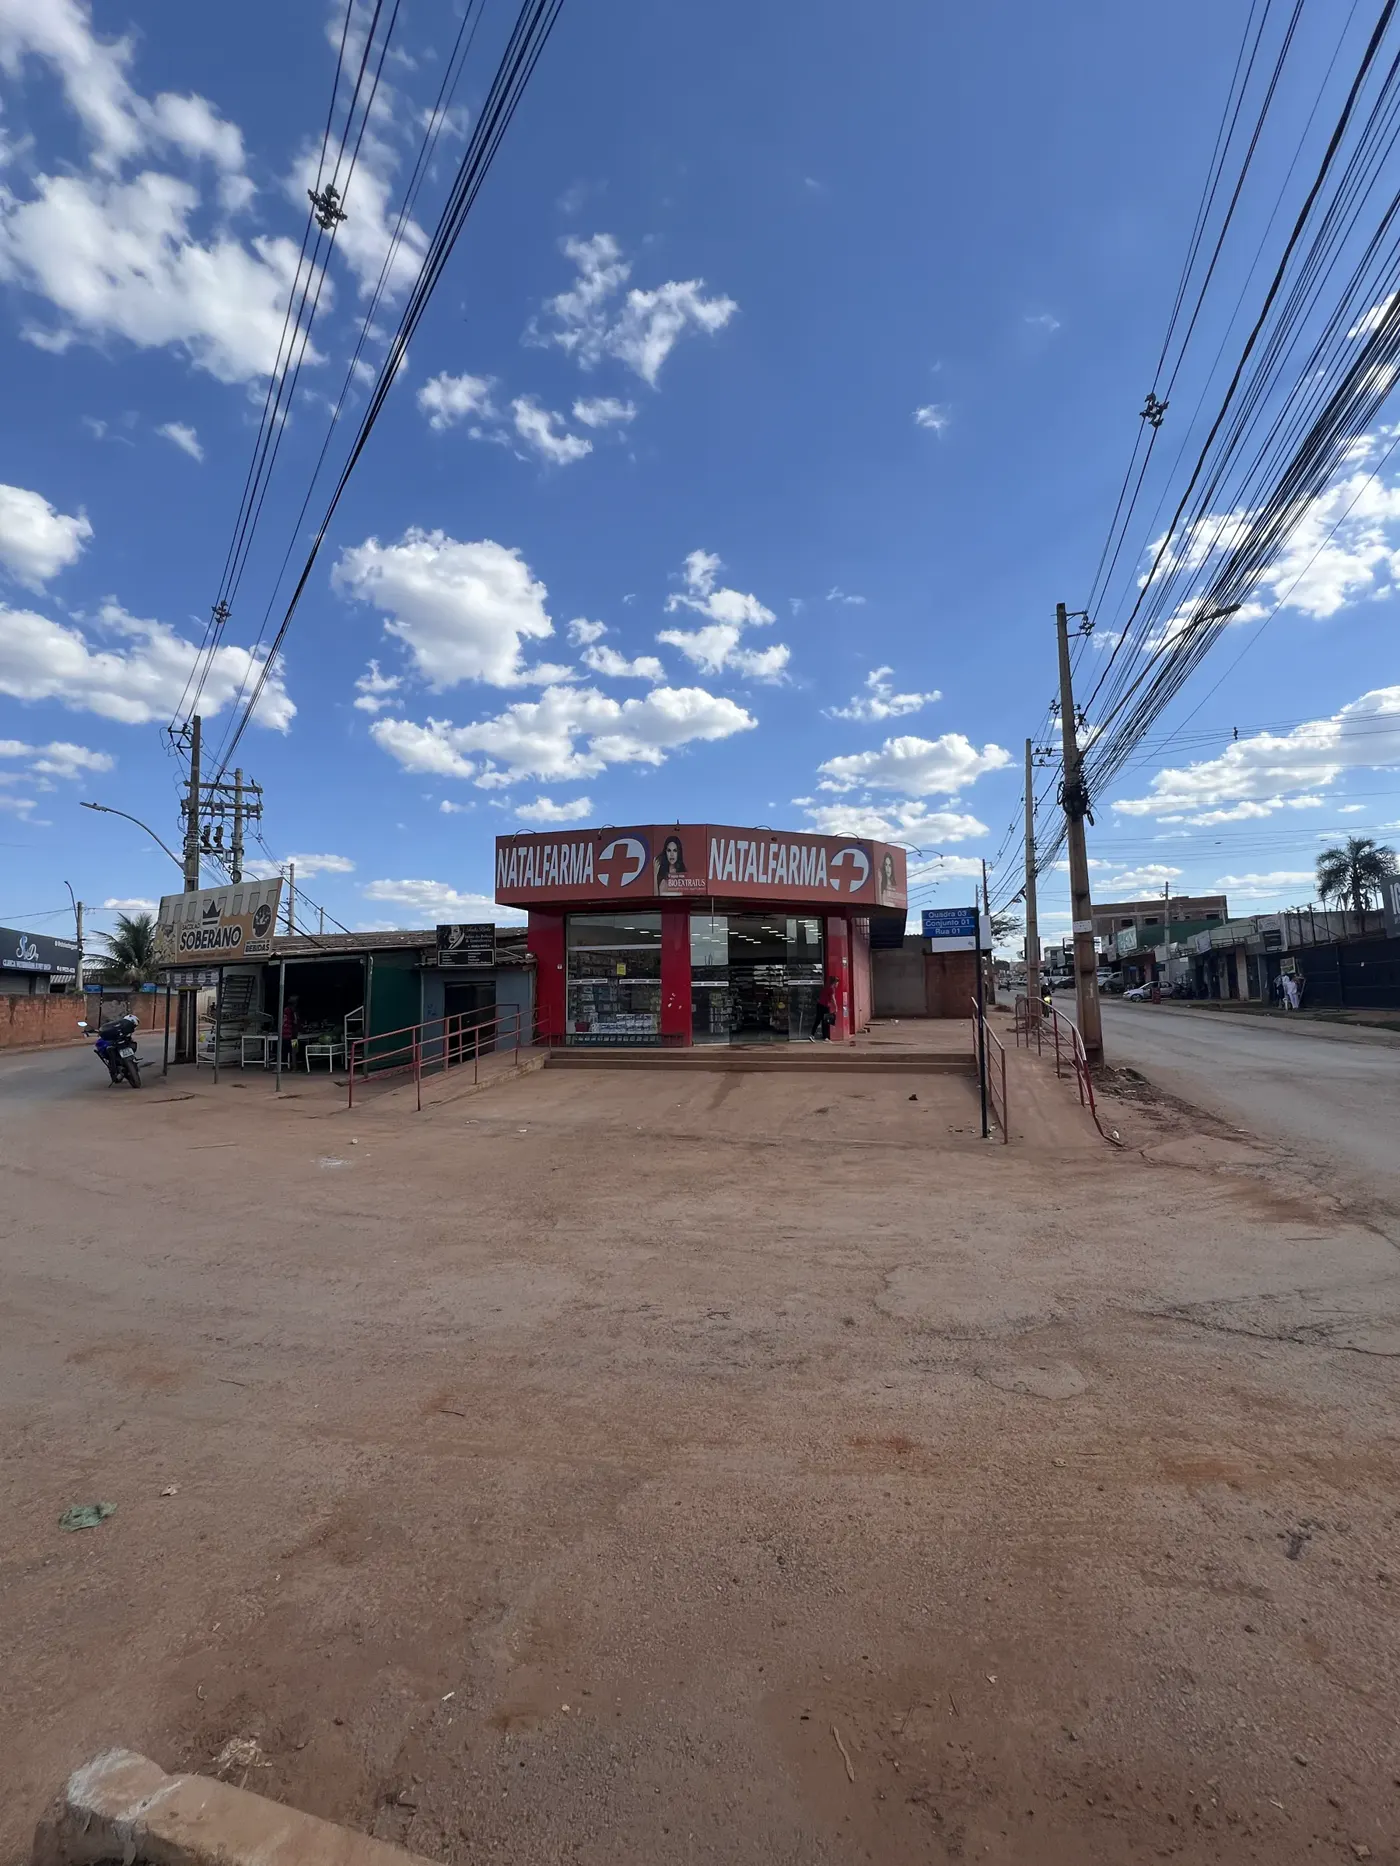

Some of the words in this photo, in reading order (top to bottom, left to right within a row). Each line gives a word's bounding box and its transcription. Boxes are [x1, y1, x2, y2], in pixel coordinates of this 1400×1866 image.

[496, 842, 593, 889] NATALFARMA
[708, 838, 827, 887] NATALFARMA
[678, 879, 706, 887] EXTRATUS
[925, 919, 959, 928] Conjunto
[179, 926, 242, 951] SOBERANO
[245, 943, 270, 953] BEBIDAS
